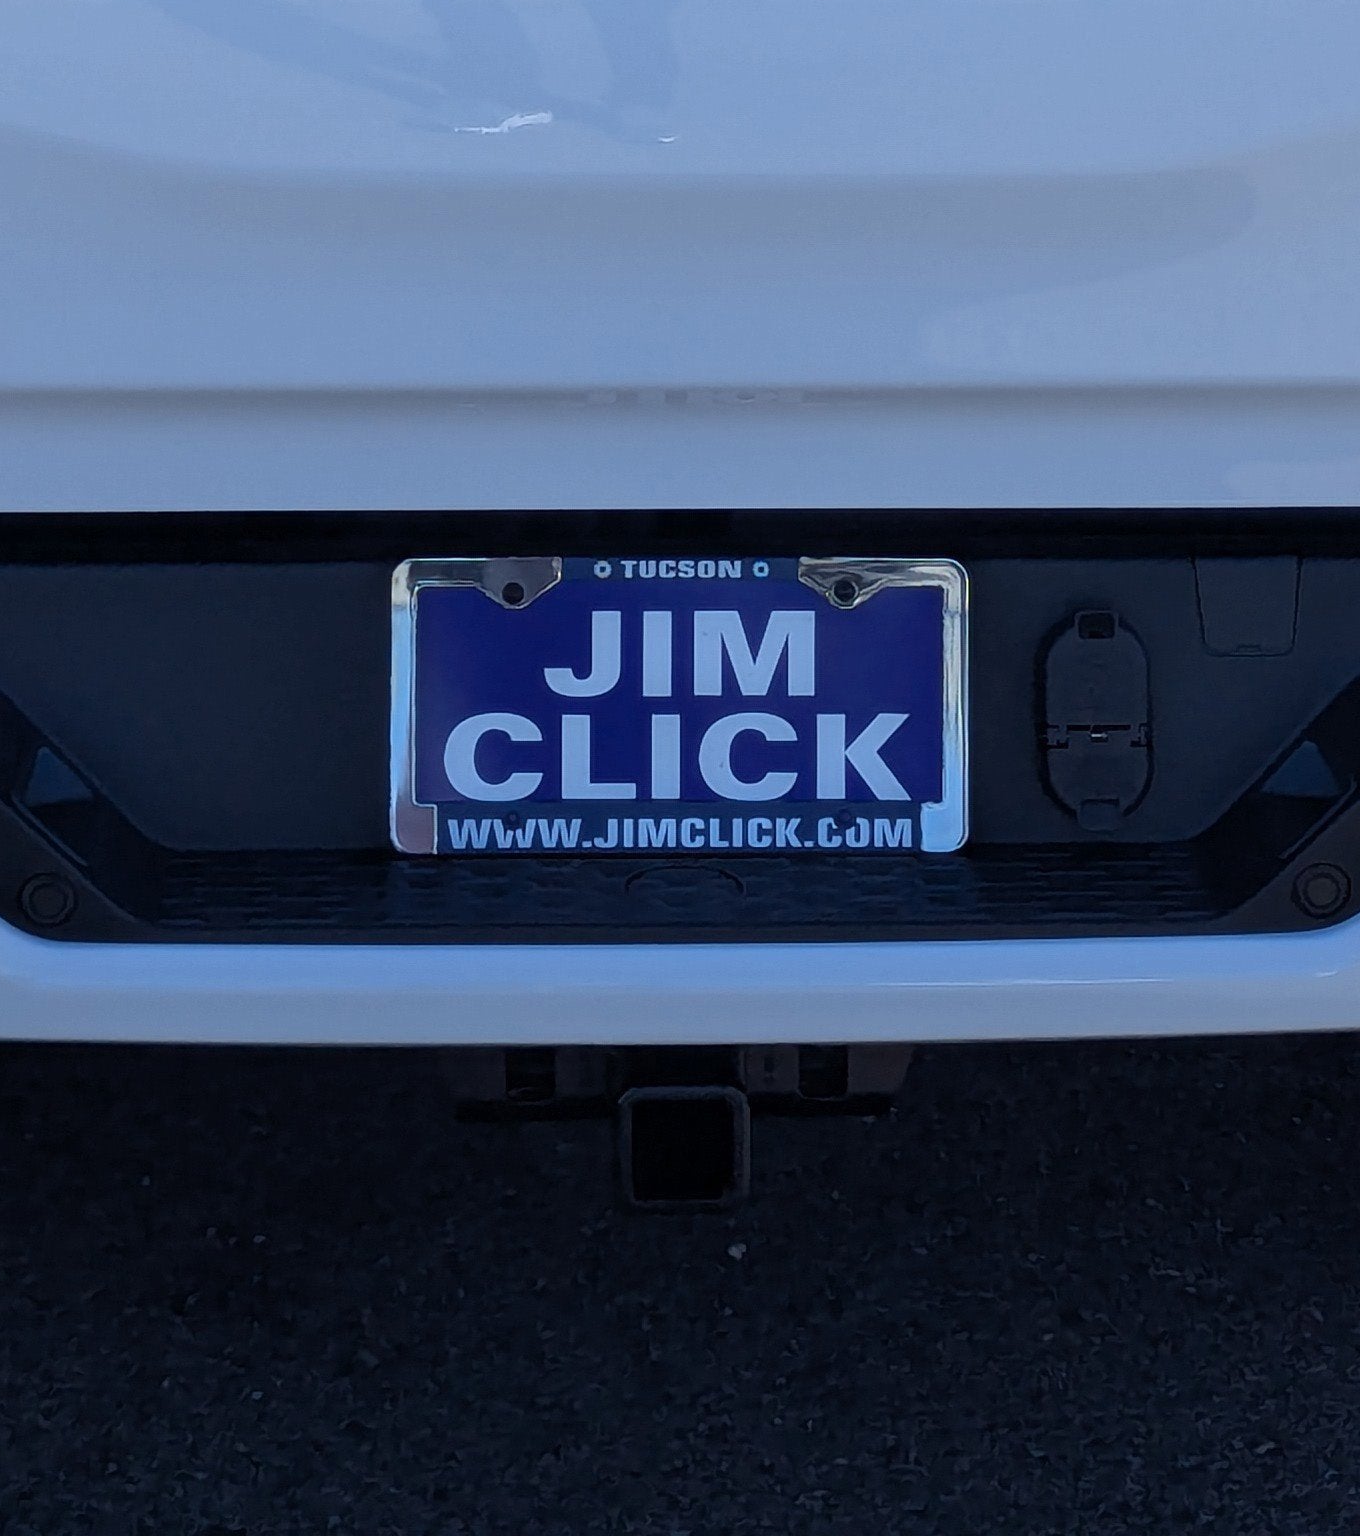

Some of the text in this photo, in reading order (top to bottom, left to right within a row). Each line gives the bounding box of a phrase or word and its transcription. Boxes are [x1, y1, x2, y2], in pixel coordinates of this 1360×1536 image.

[620, 560, 742, 579] TUCSON
[543, 610, 816, 698] JIM
[443, 712, 911, 801] CLICK
[447, 817, 913, 850] WWW.JIMCLICK.COM
